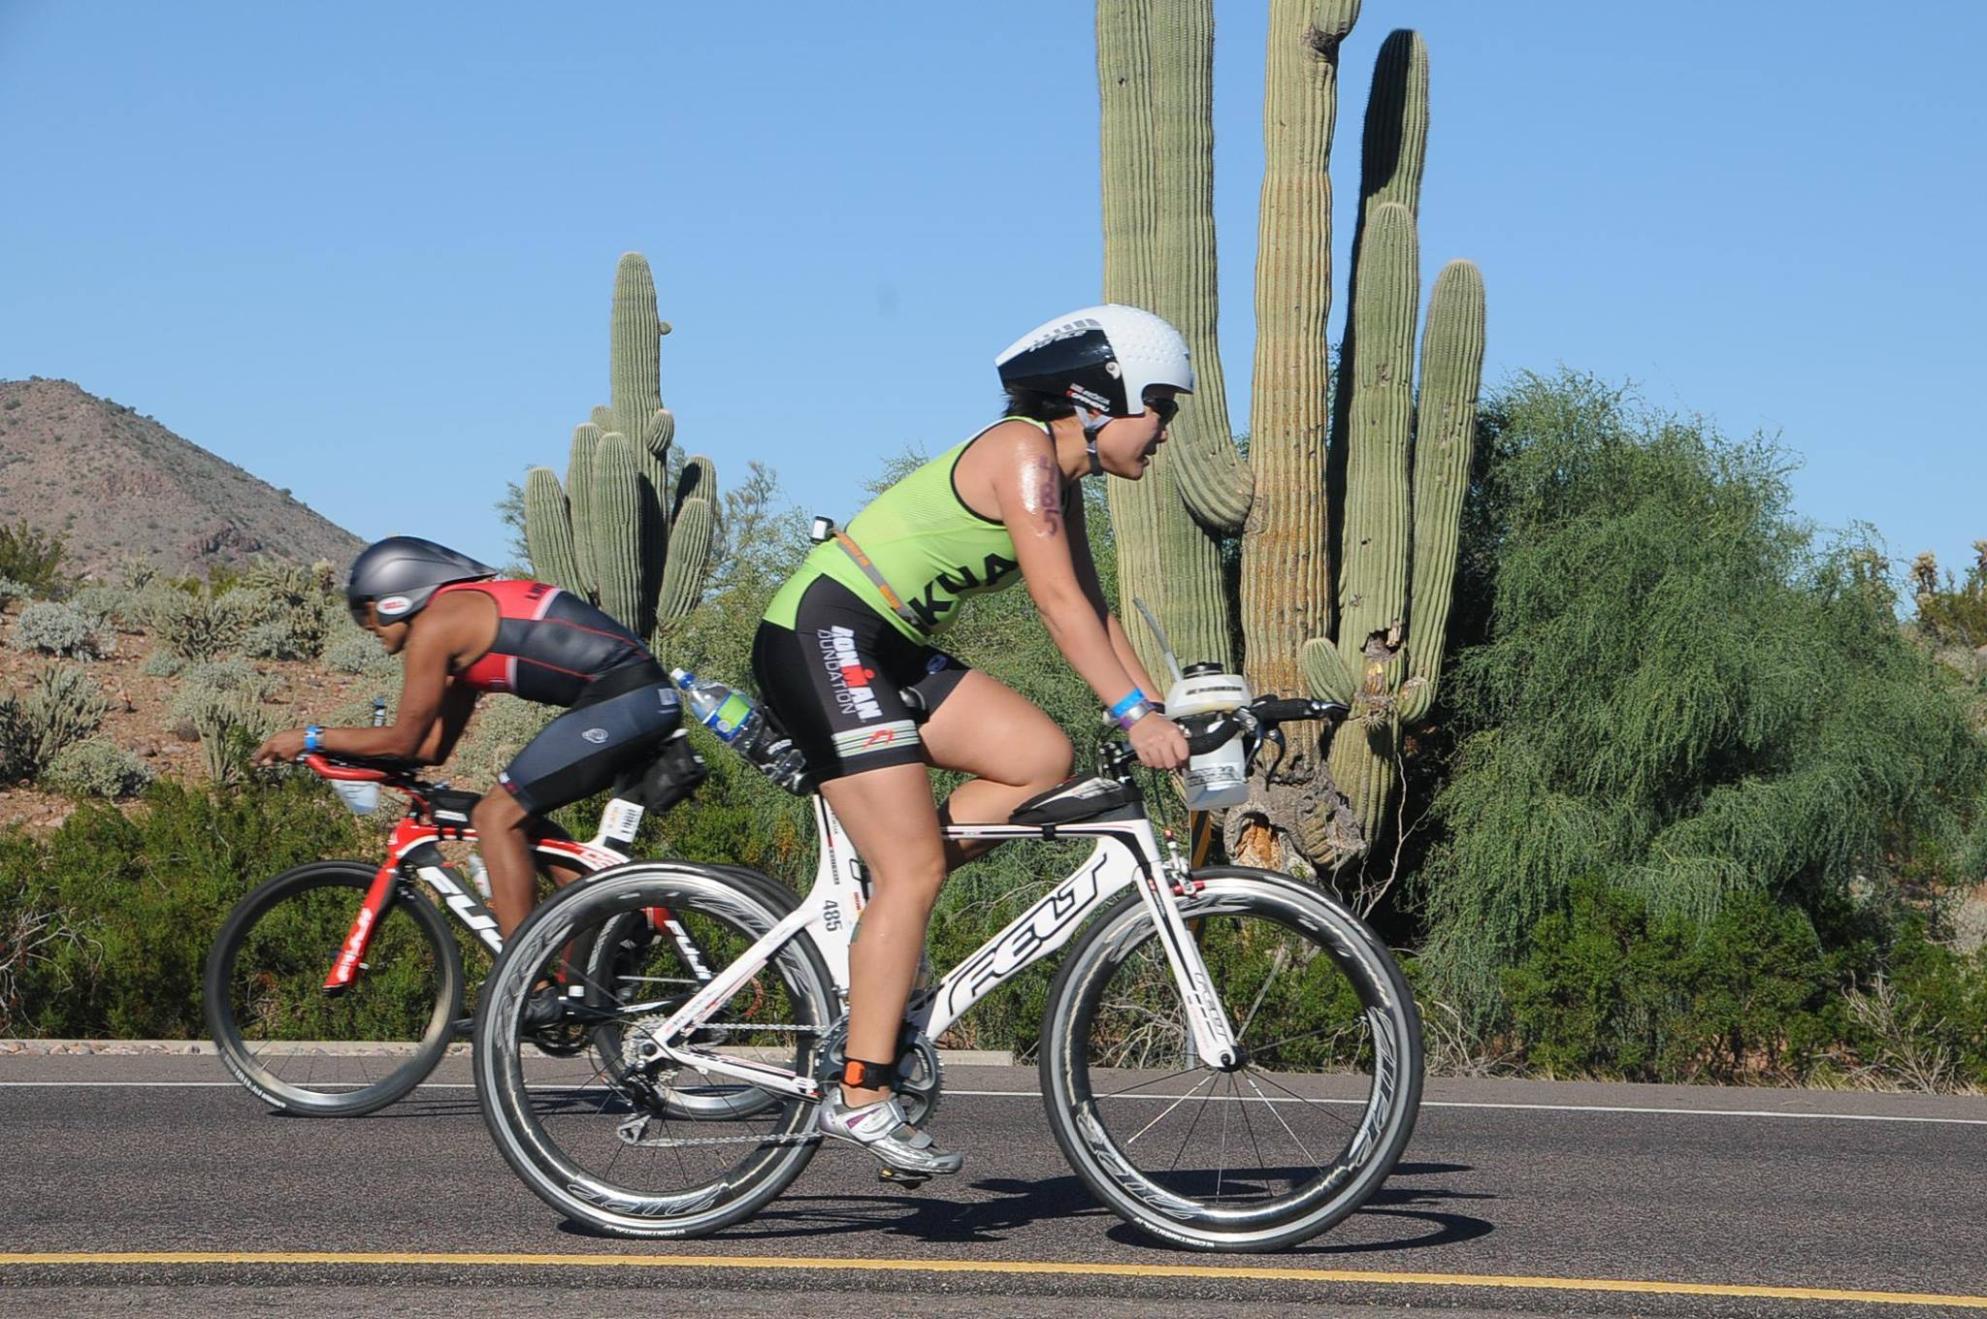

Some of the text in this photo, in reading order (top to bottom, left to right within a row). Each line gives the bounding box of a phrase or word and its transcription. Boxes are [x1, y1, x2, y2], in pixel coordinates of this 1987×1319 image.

[816, 629, 856, 714] OUNDATION
[416, 866, 504, 955] FUJ
[823, 900, 843, 932] 485
[949, 852, 1108, 1017] FELT
